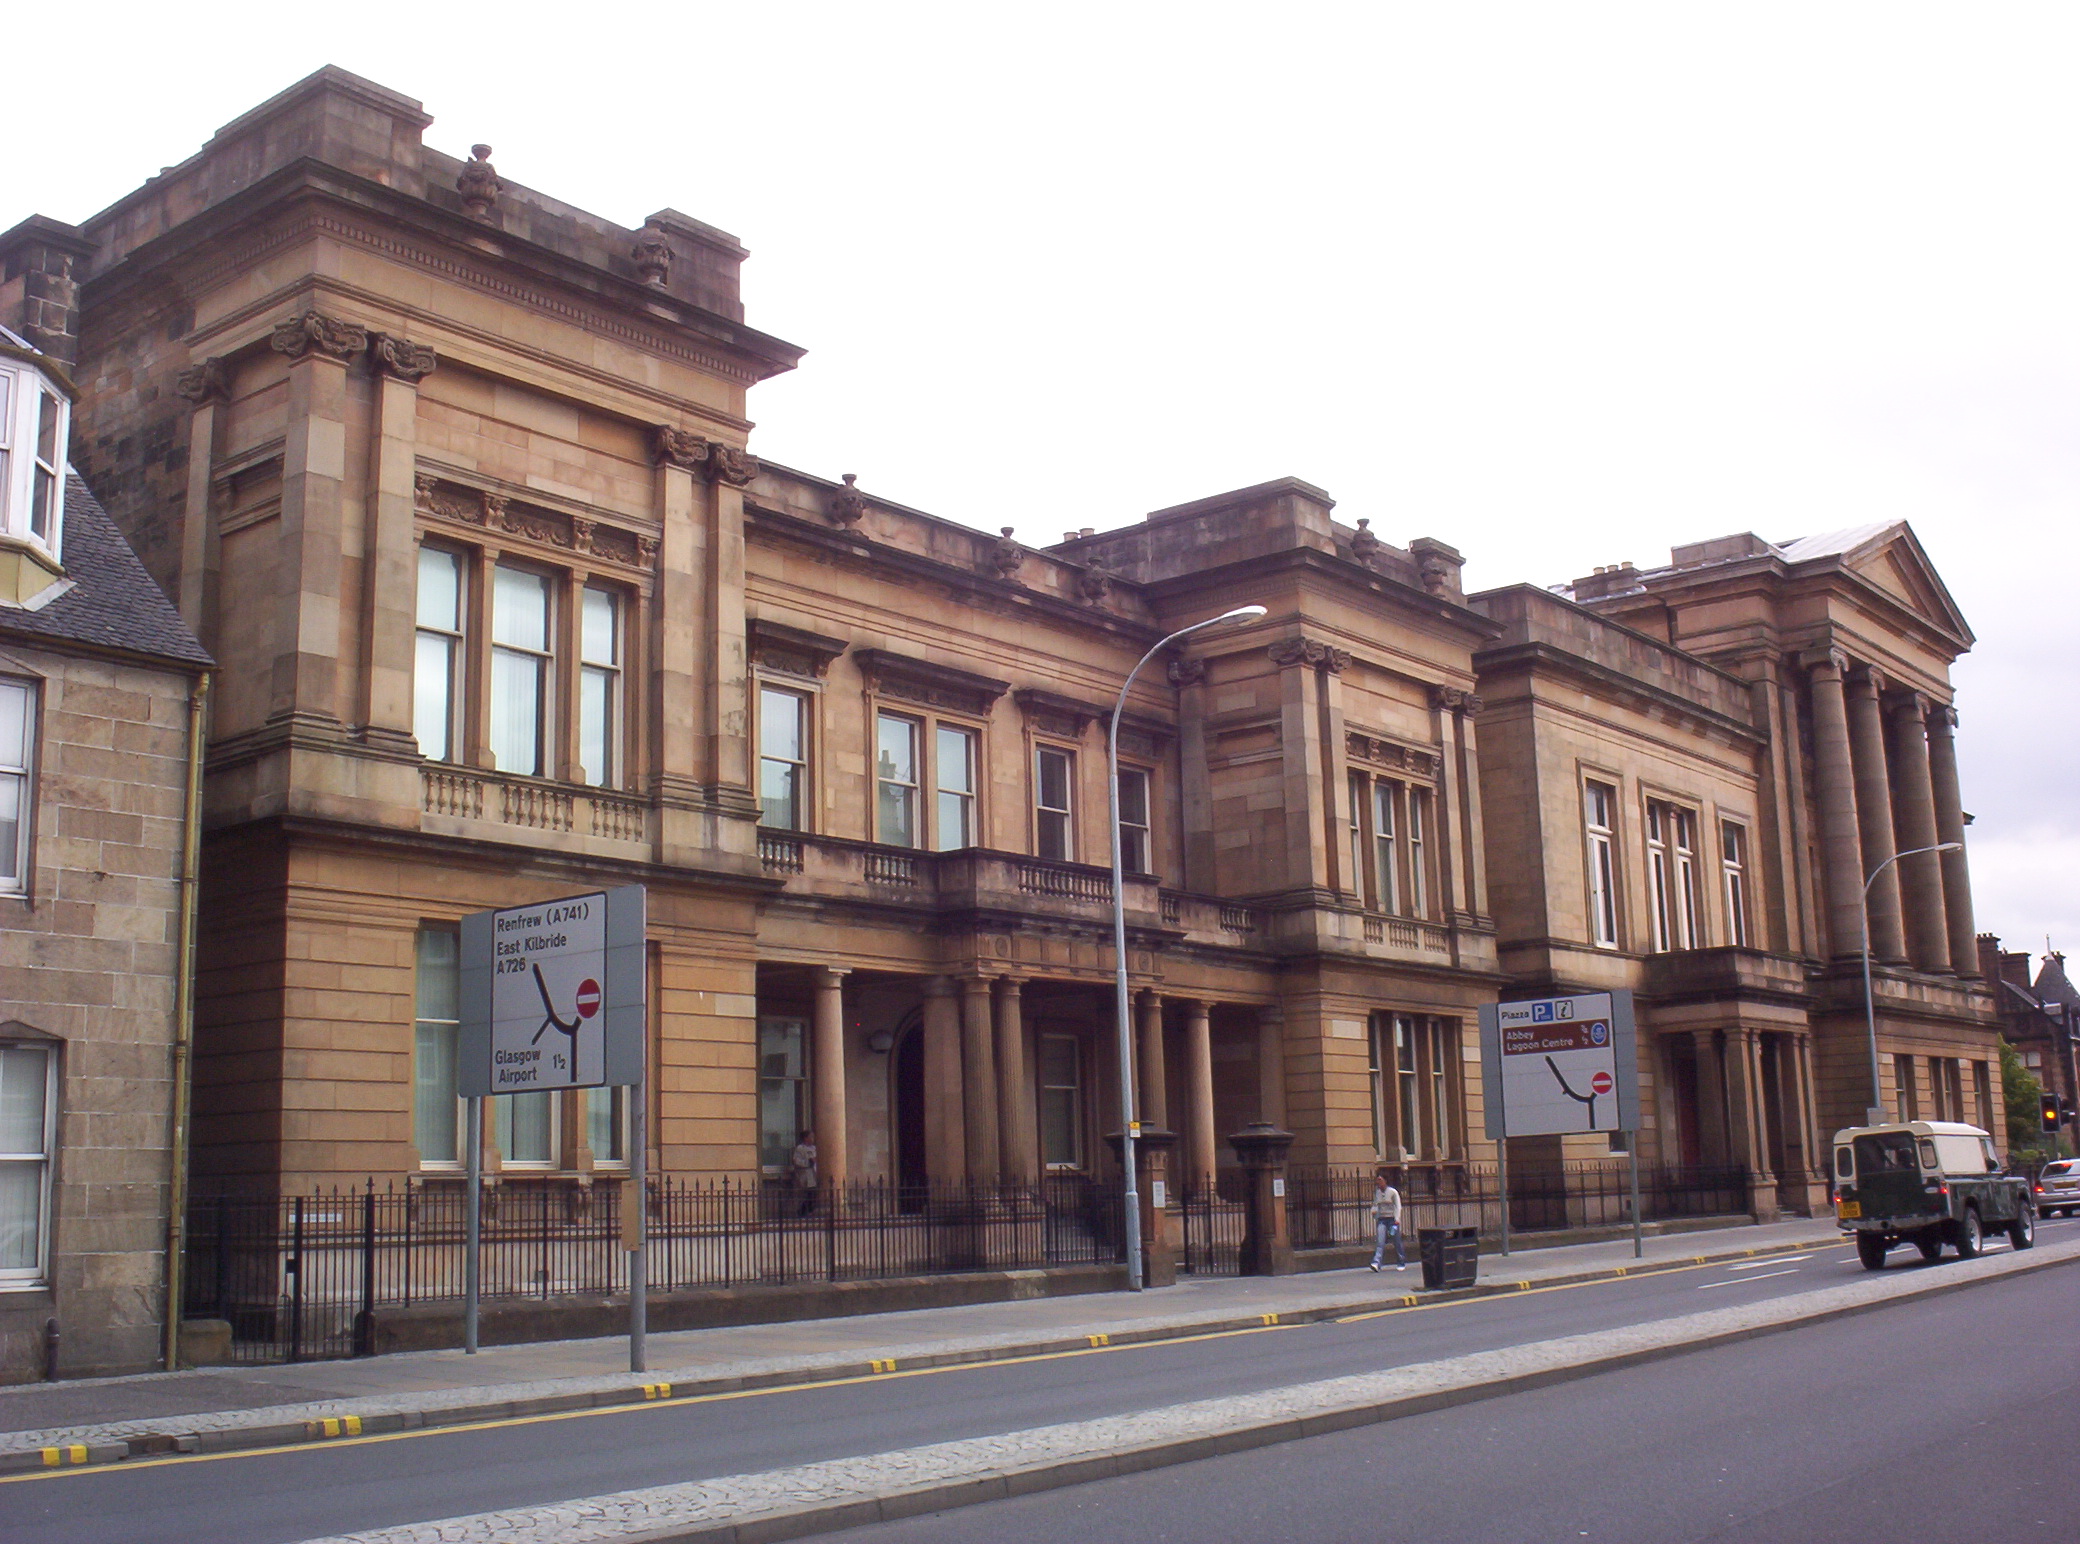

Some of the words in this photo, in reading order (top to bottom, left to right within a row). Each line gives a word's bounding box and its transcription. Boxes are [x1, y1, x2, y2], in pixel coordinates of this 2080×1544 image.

[497, 916, 542, 932] Renfrew
[546, 903, 589, 926] (A741)
[497, 941, 521, 956] East
[525, 934, 567, 951] Kilbride
[1507, 1031, 1534, 1040] Abbey
[1507, 1041, 1539, 1052] Lagoon
[1542, 1038, 1573, 1048] Centre
[495, 1049, 541, 1066] Glasgow
[498, 1069, 537, 1084] Airport
